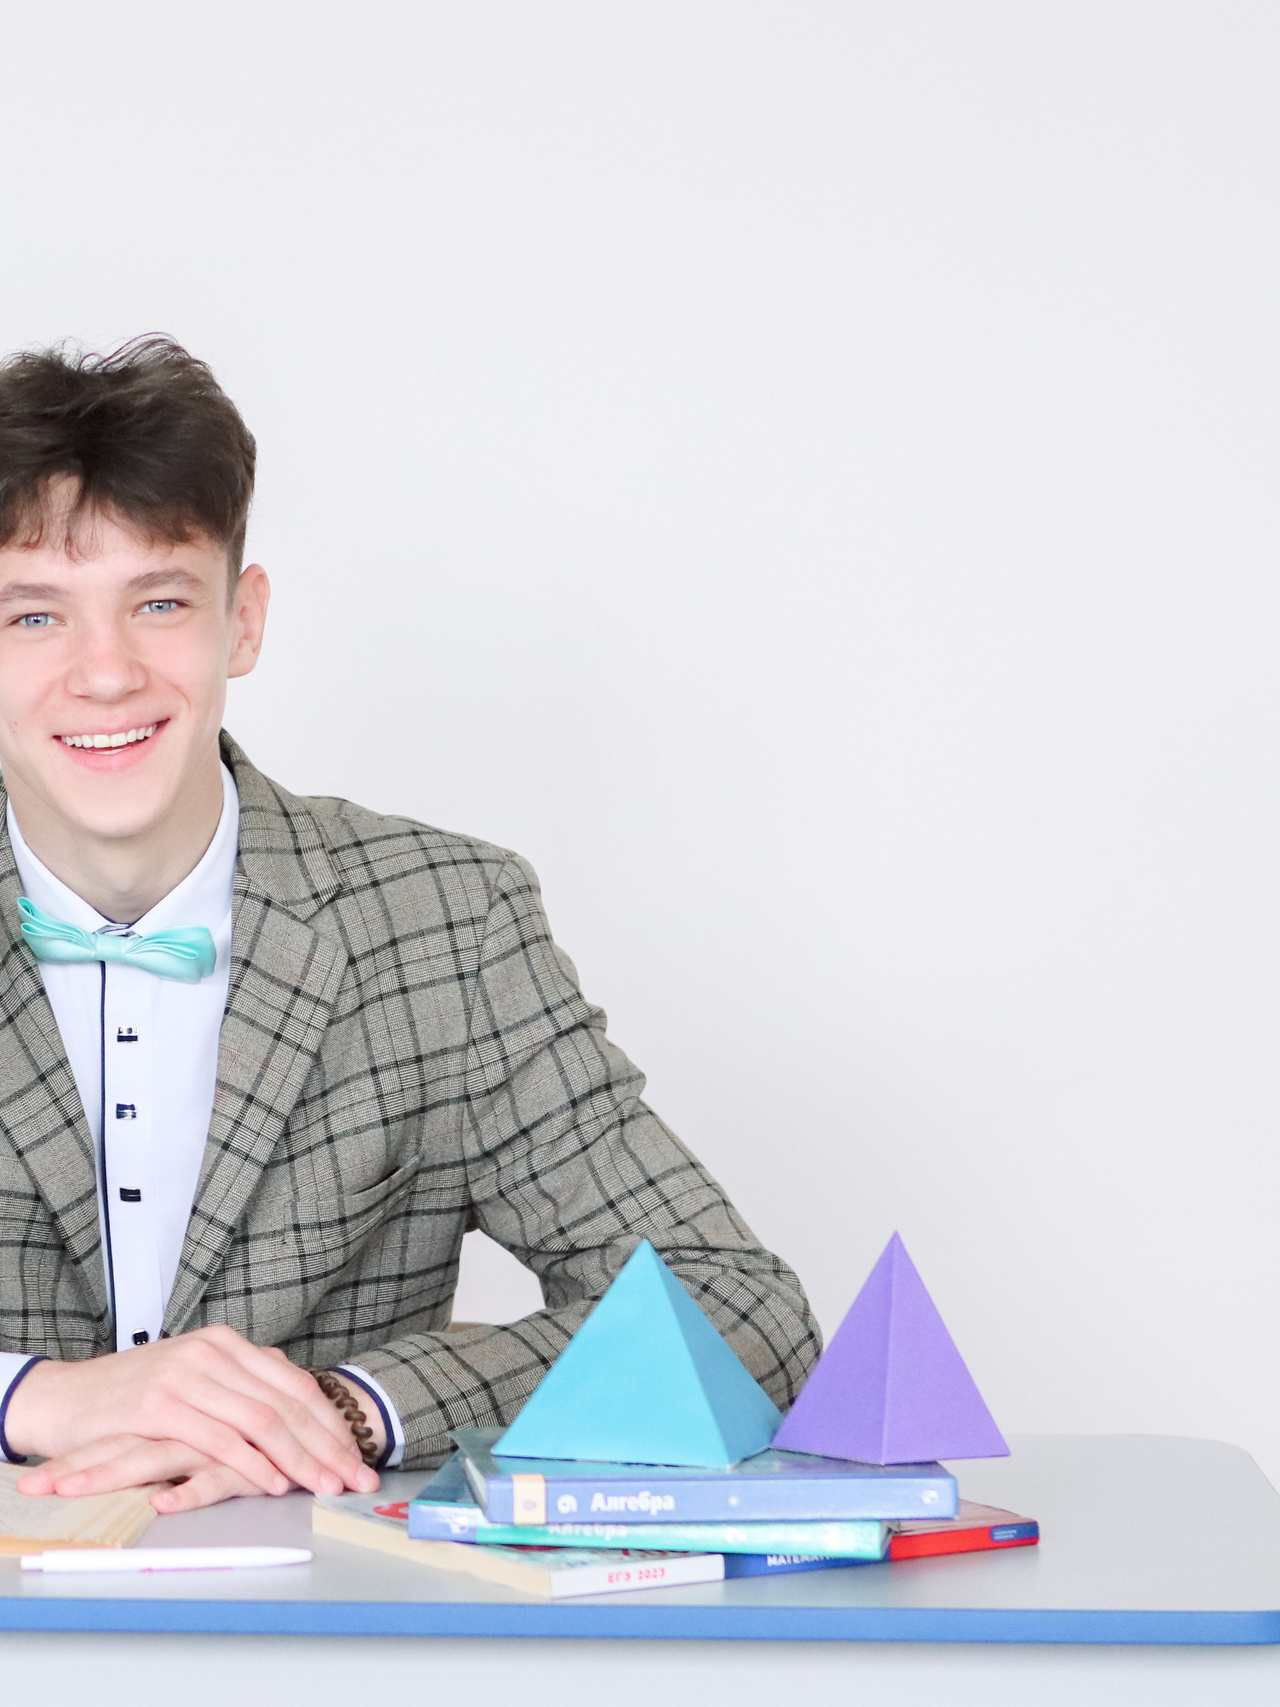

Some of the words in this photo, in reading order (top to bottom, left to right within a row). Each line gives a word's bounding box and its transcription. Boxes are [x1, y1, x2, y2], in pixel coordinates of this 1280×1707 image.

[591, 1491, 675, 1516] Алгебра
[607, 1571, 632, 1584] ЕГЭ
[637, 1567, 666, 1580] 2023
